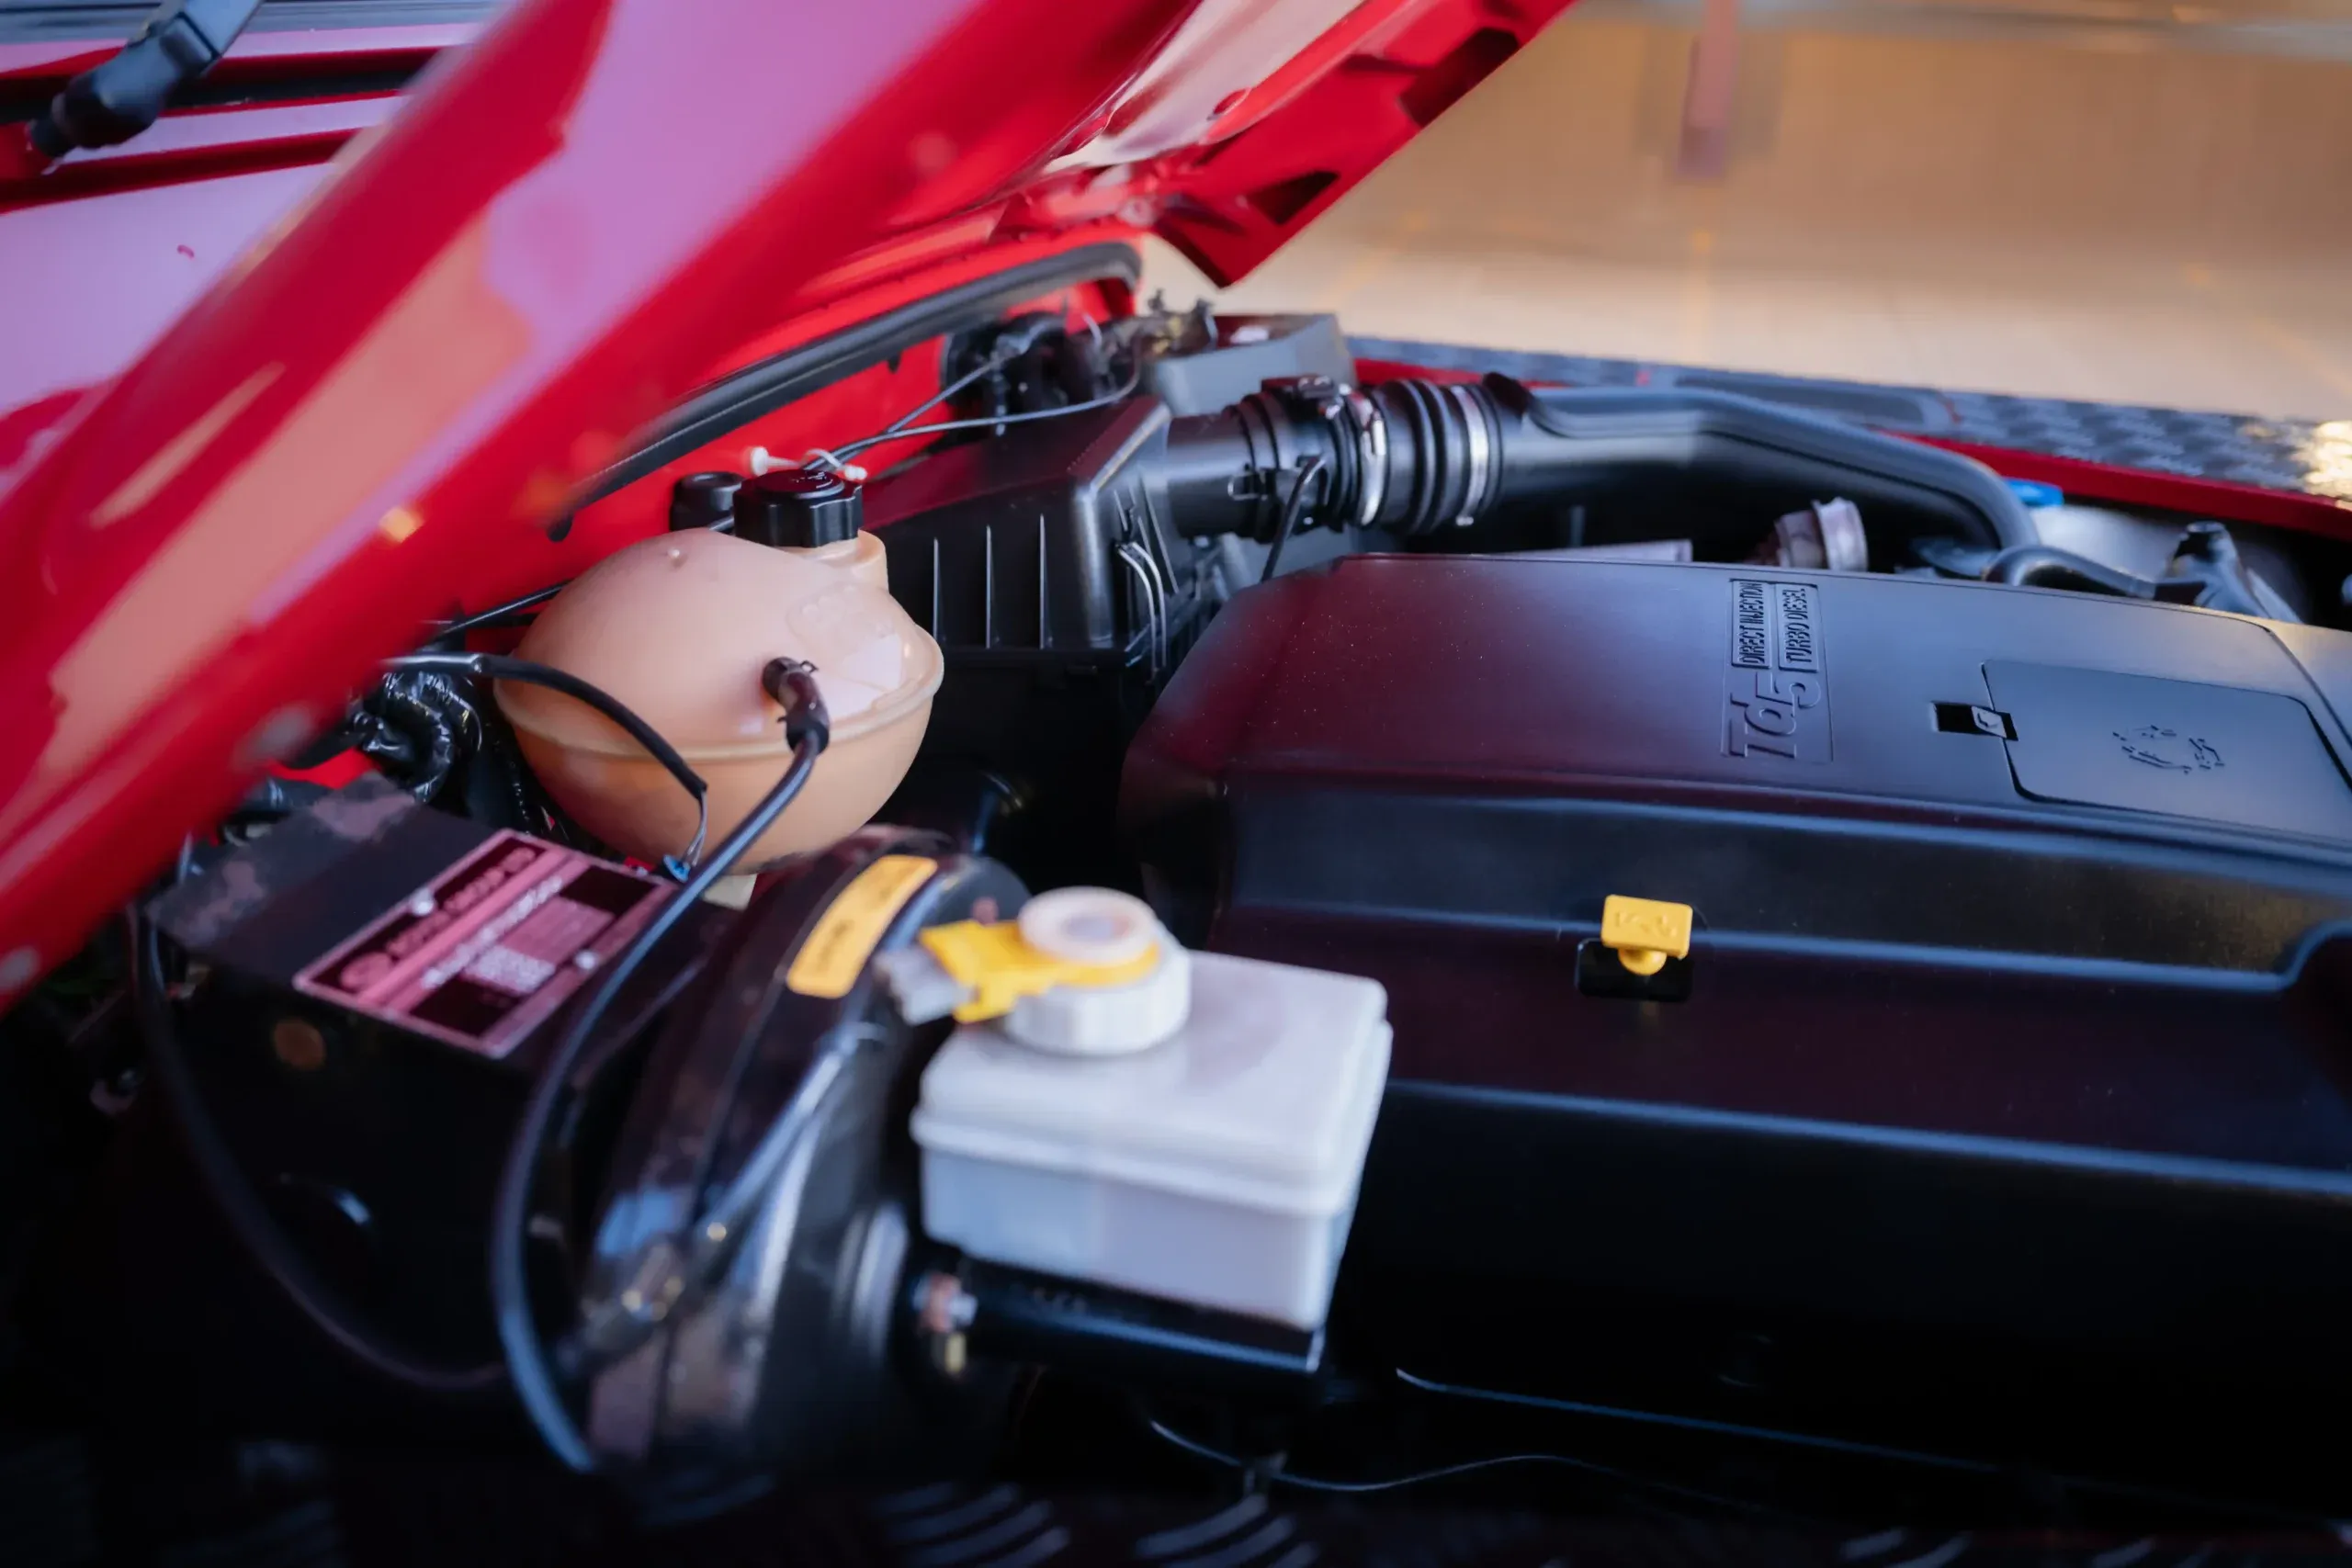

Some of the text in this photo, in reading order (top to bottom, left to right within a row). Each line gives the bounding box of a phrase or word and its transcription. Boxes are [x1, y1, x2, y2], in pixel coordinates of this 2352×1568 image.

[1738, 581, 1765, 664] DIRECT INJECTION
[1781, 588, 1812, 663] TURBO DIESEL
